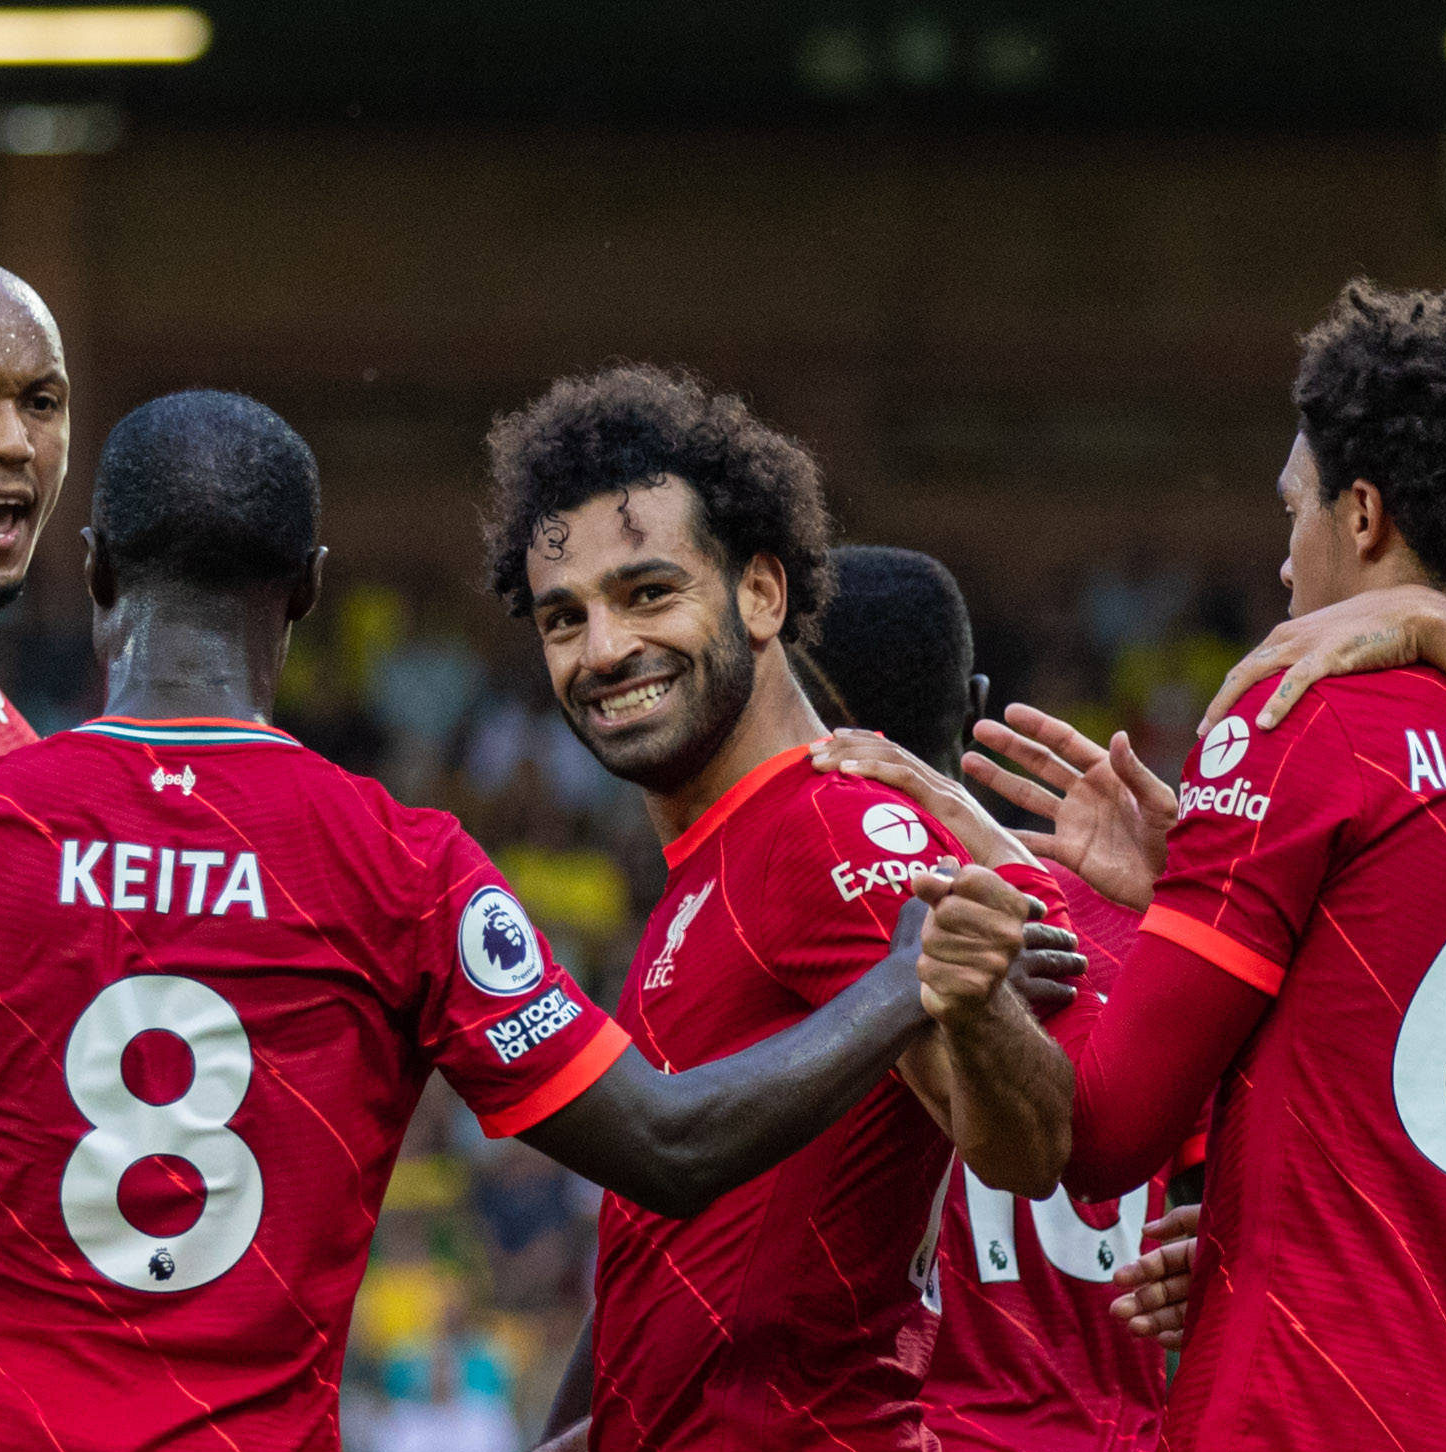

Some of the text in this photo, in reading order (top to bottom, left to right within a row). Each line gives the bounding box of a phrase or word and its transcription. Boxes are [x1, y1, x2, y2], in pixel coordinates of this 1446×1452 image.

[165, 773, 183, 786] 96
[59, 838, 269, 920] KEITA
[643, 964, 675, 991] LFC
[484, 1019, 522, 1049] No
[496, 1035, 530, 1065] for
[59, 973, 265, 1294] 8
